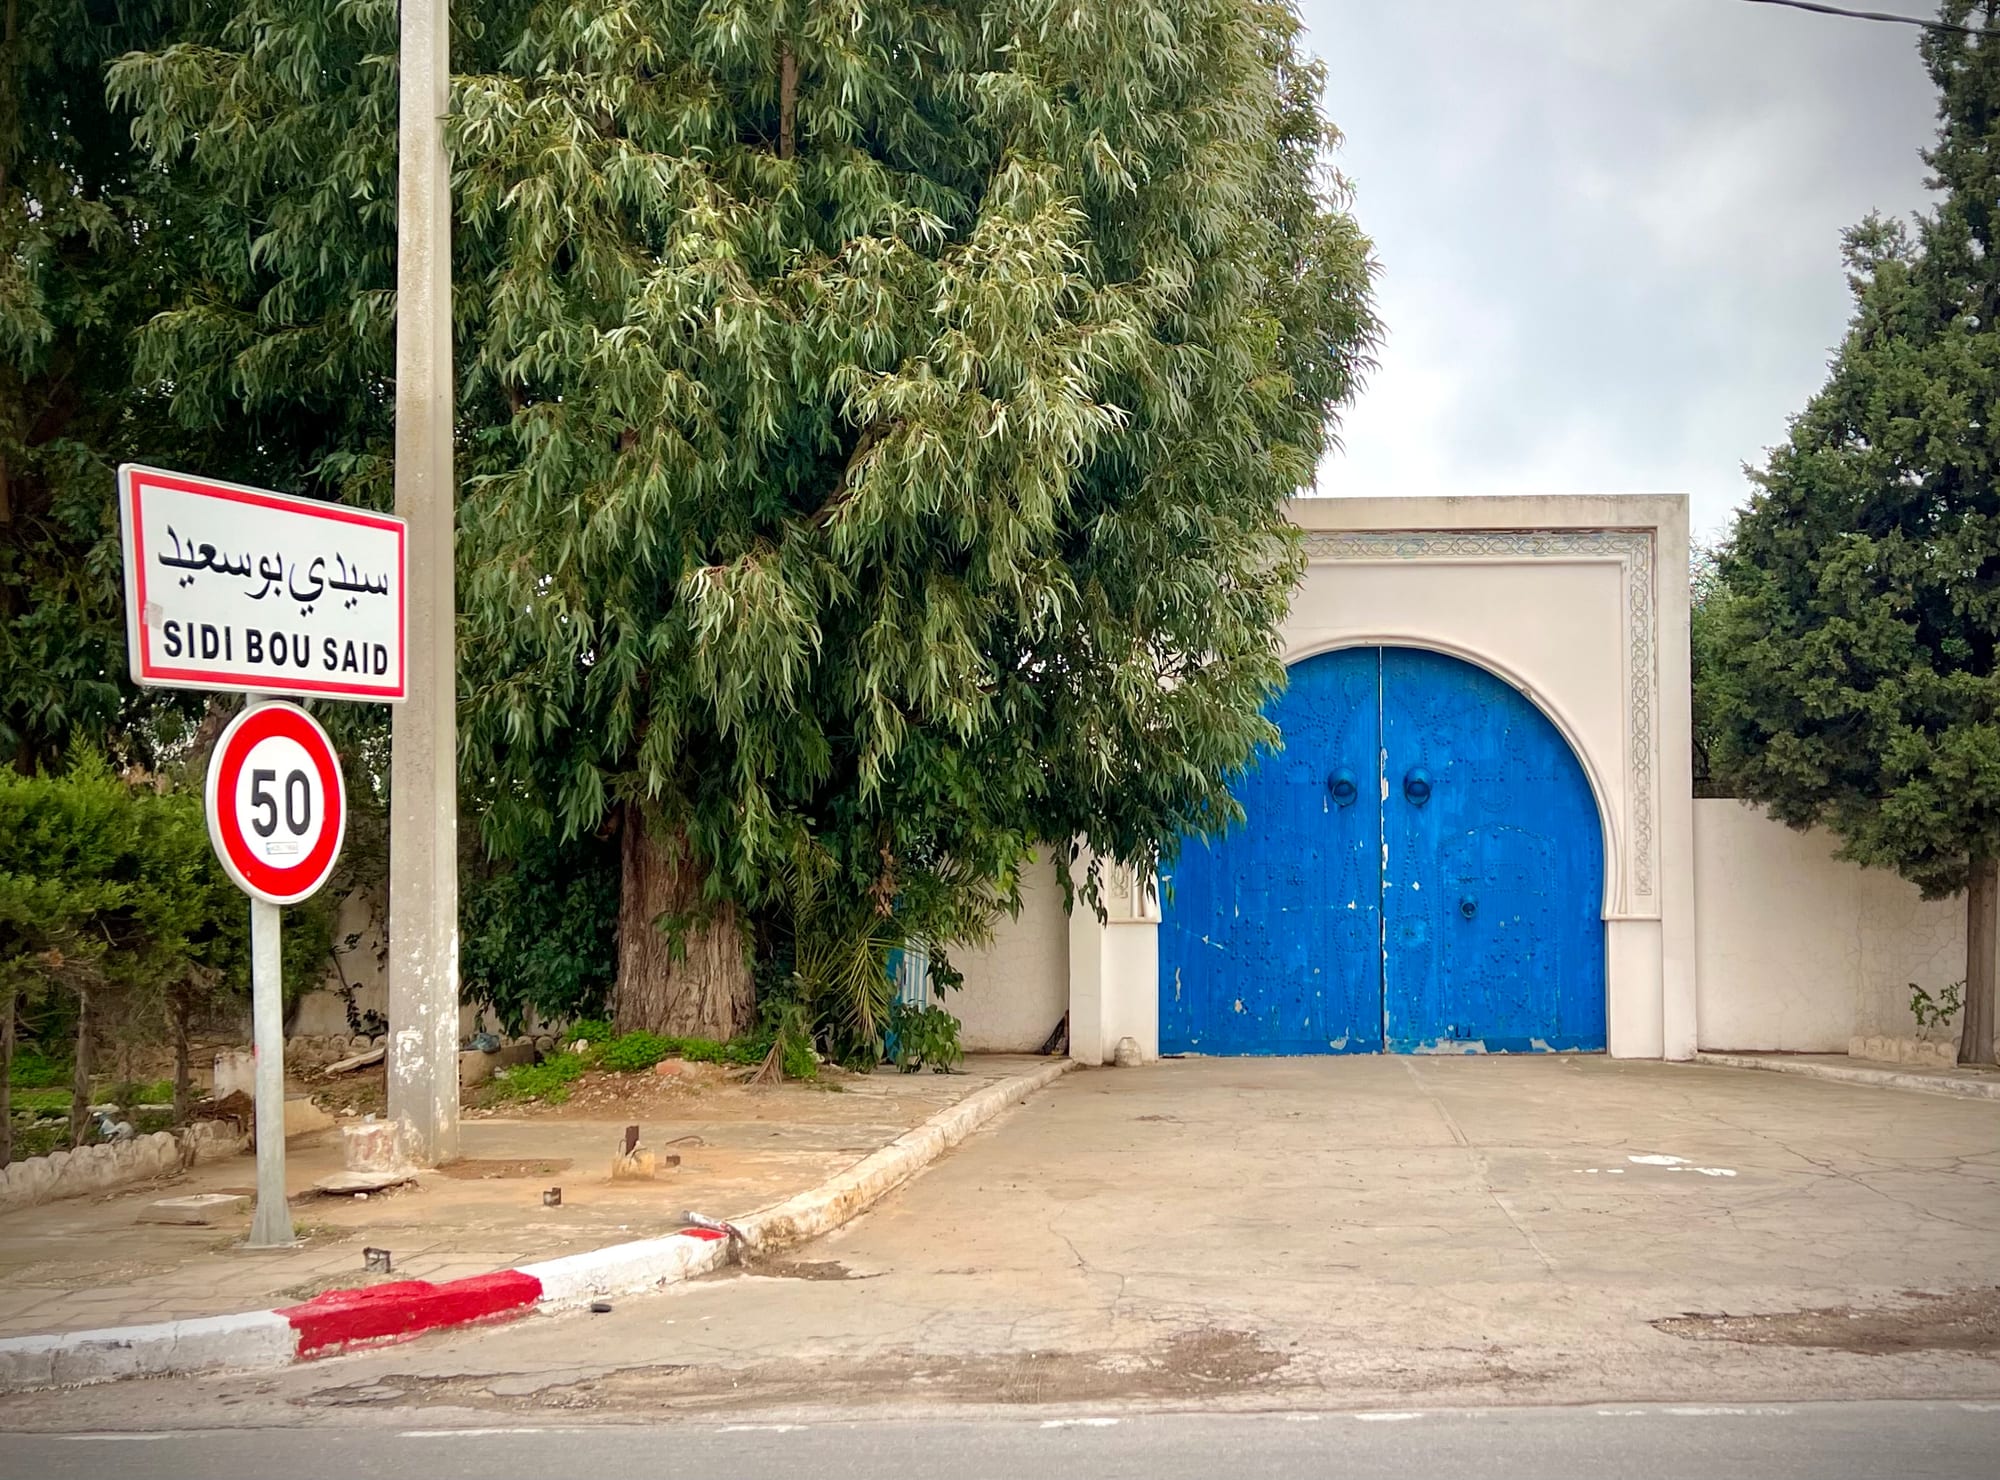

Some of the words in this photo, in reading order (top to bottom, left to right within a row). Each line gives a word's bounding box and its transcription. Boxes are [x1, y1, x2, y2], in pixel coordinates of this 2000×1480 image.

[289, 551, 388, 617] سيدي
[163, 620, 232, 661] SIDI
[246, 628, 310, 668] BOU
[323, 637, 388, 676] SAID
[251, 768, 311, 837] 50
